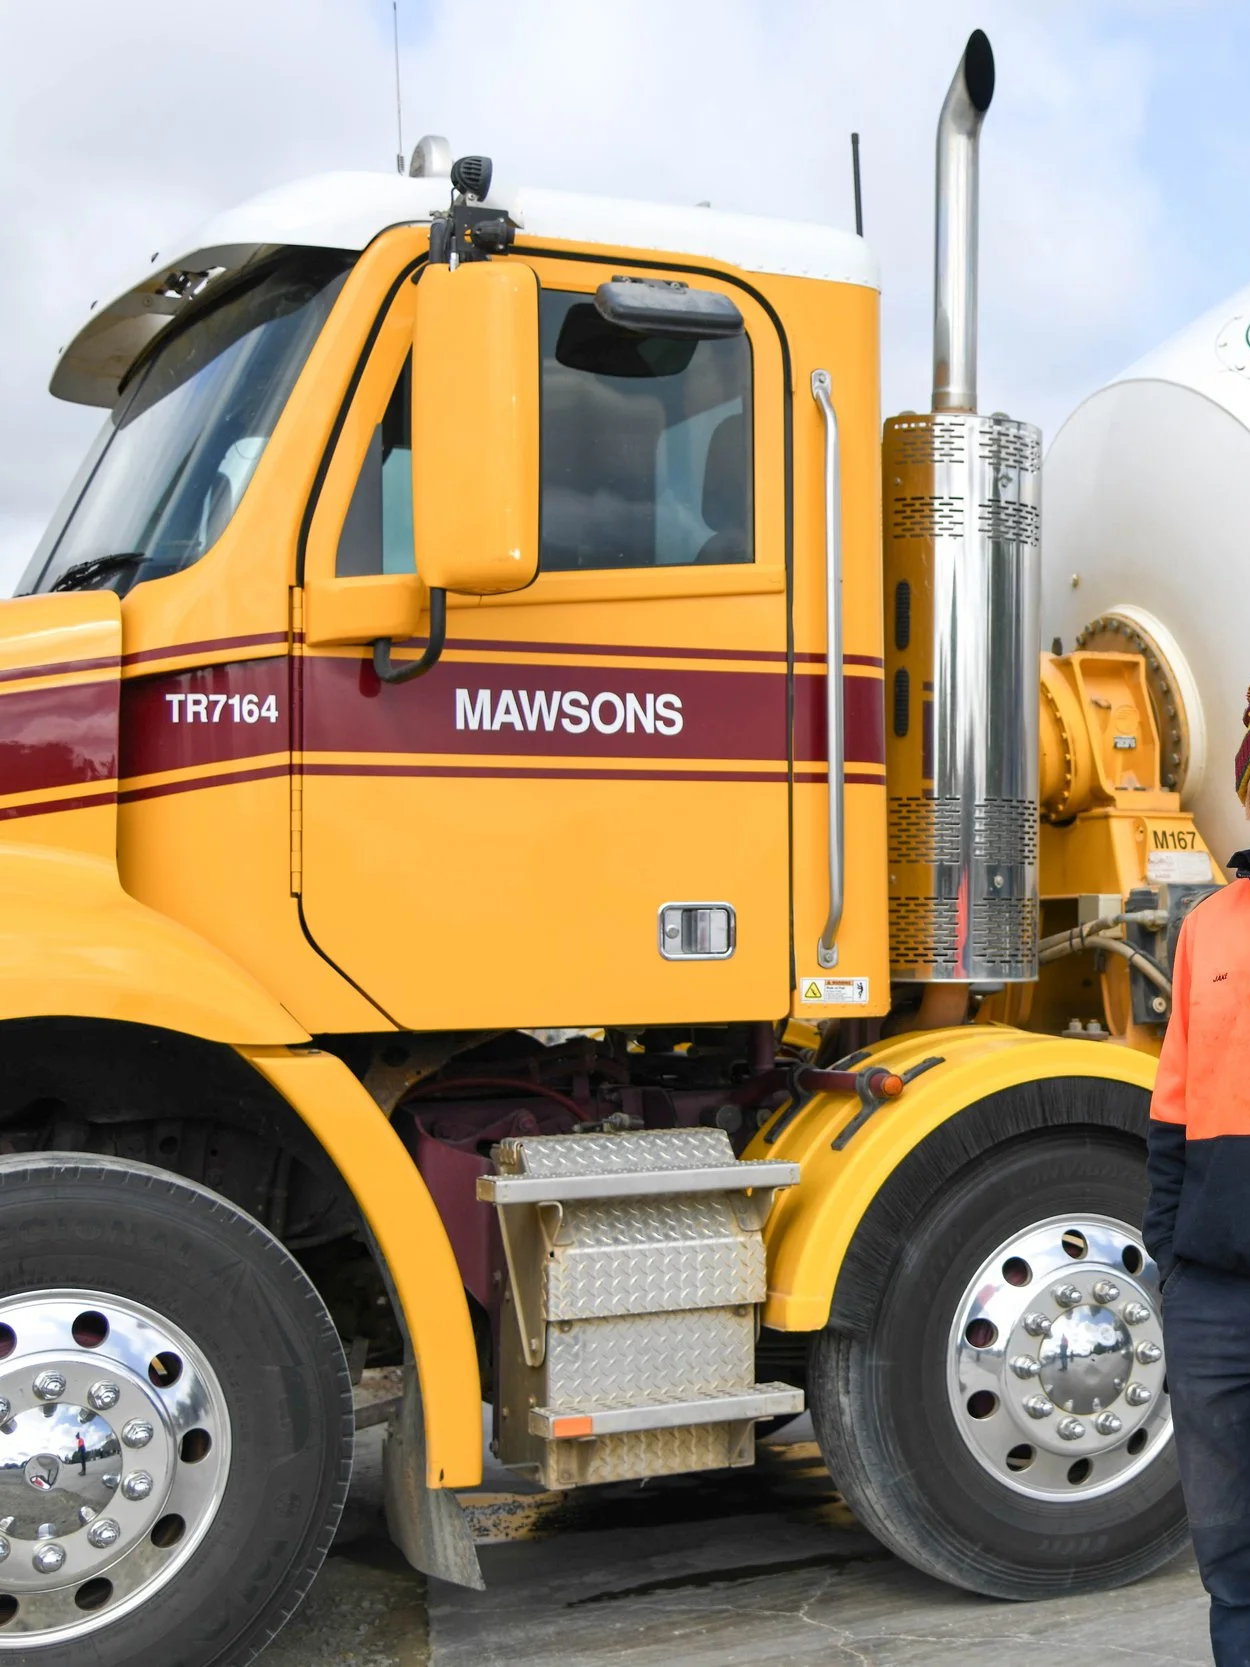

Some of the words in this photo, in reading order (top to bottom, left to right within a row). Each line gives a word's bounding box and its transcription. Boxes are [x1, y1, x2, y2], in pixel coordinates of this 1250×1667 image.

[165, 693, 279, 723] TR7164
[455, 688, 684, 736] MAWSONS
[1152, 830, 1196, 850] M167
